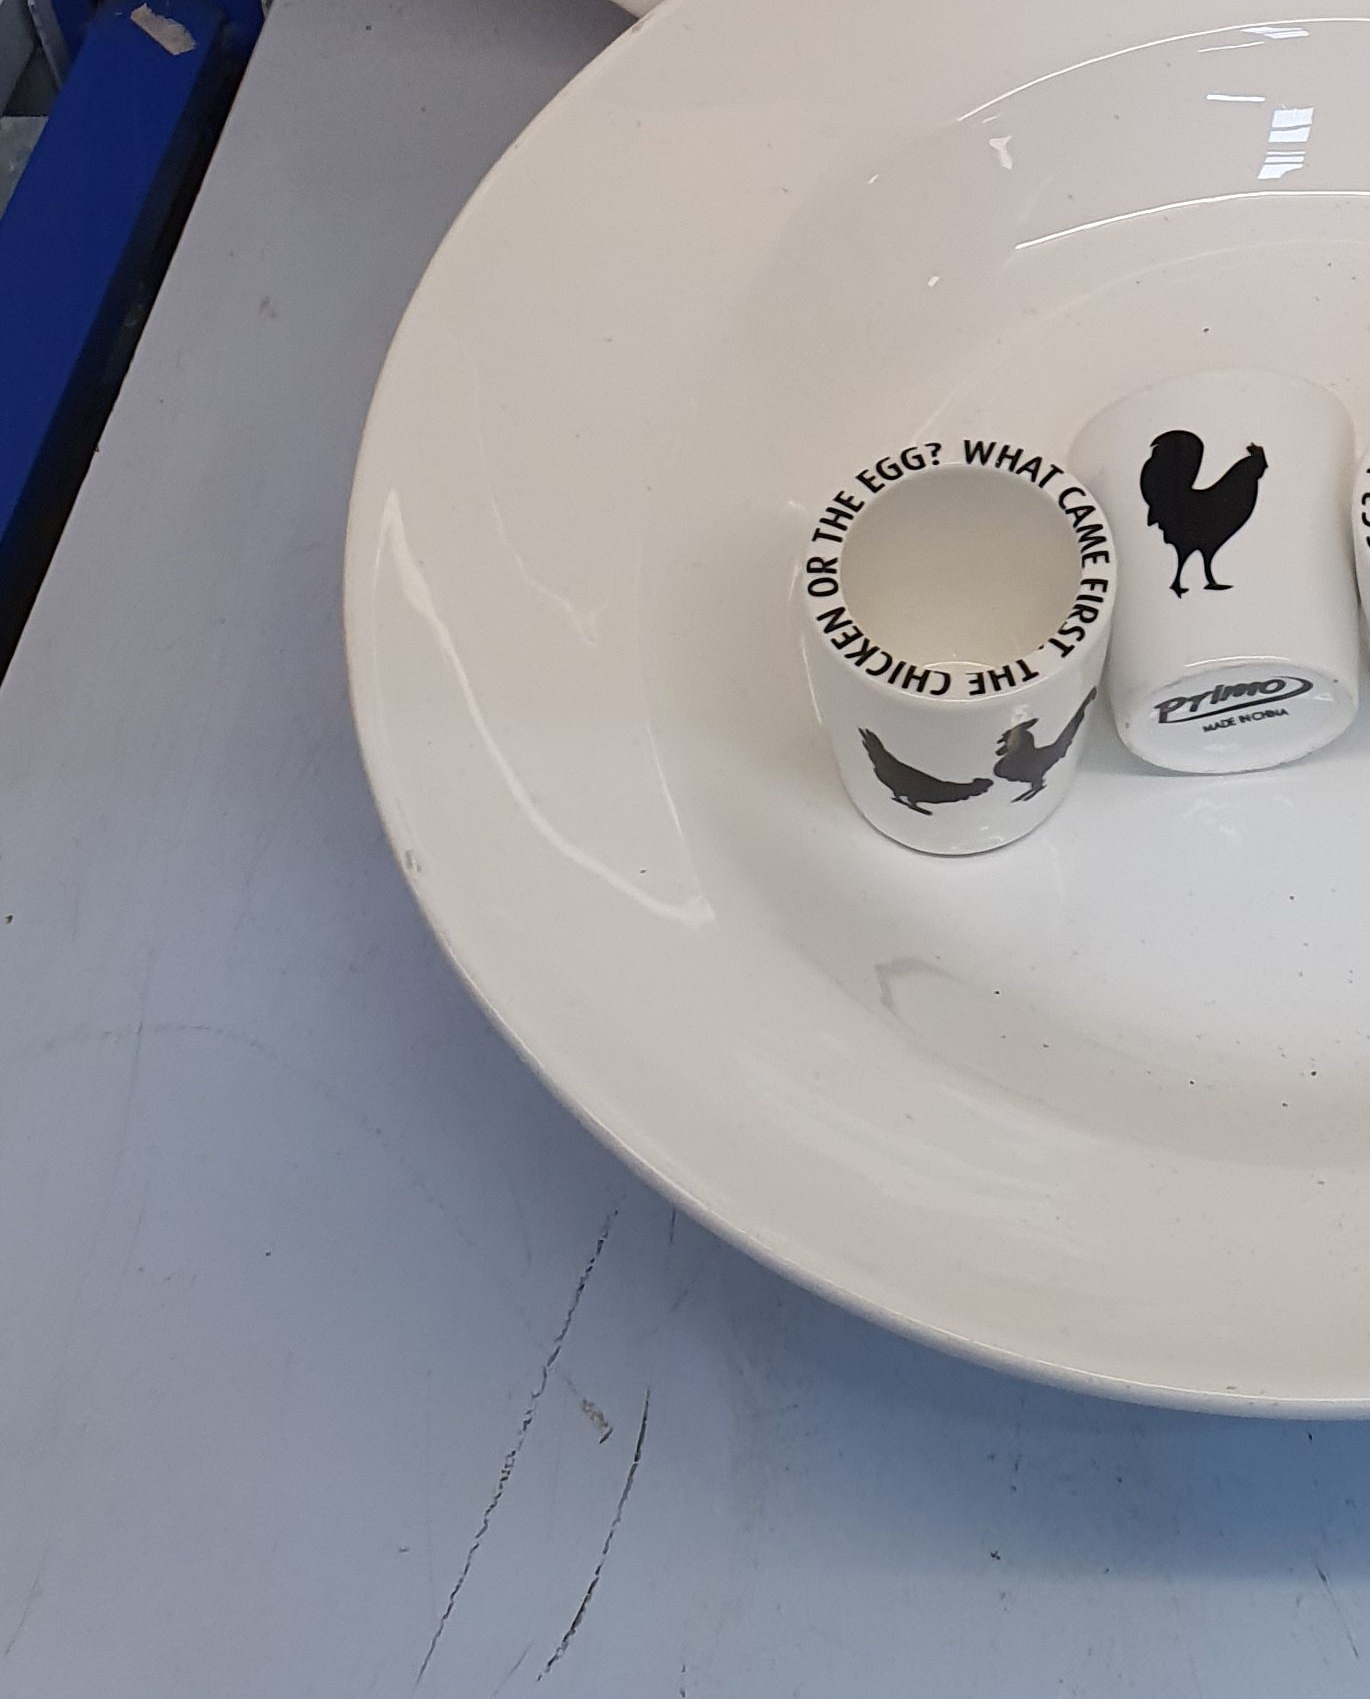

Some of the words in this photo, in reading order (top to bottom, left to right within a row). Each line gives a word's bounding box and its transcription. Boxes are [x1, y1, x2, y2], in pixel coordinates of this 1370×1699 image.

[856, 441, 943, 495] EGG?
[963, 439, 1065, 489] WHAT
[812, 489, 865, 546] THE
[1057, 486, 1111, 568] CAME
[806, 555, 839, 599] OR
[816, 606, 951, 696] CHICKEN
[968, 658, 1039, 696] THE
